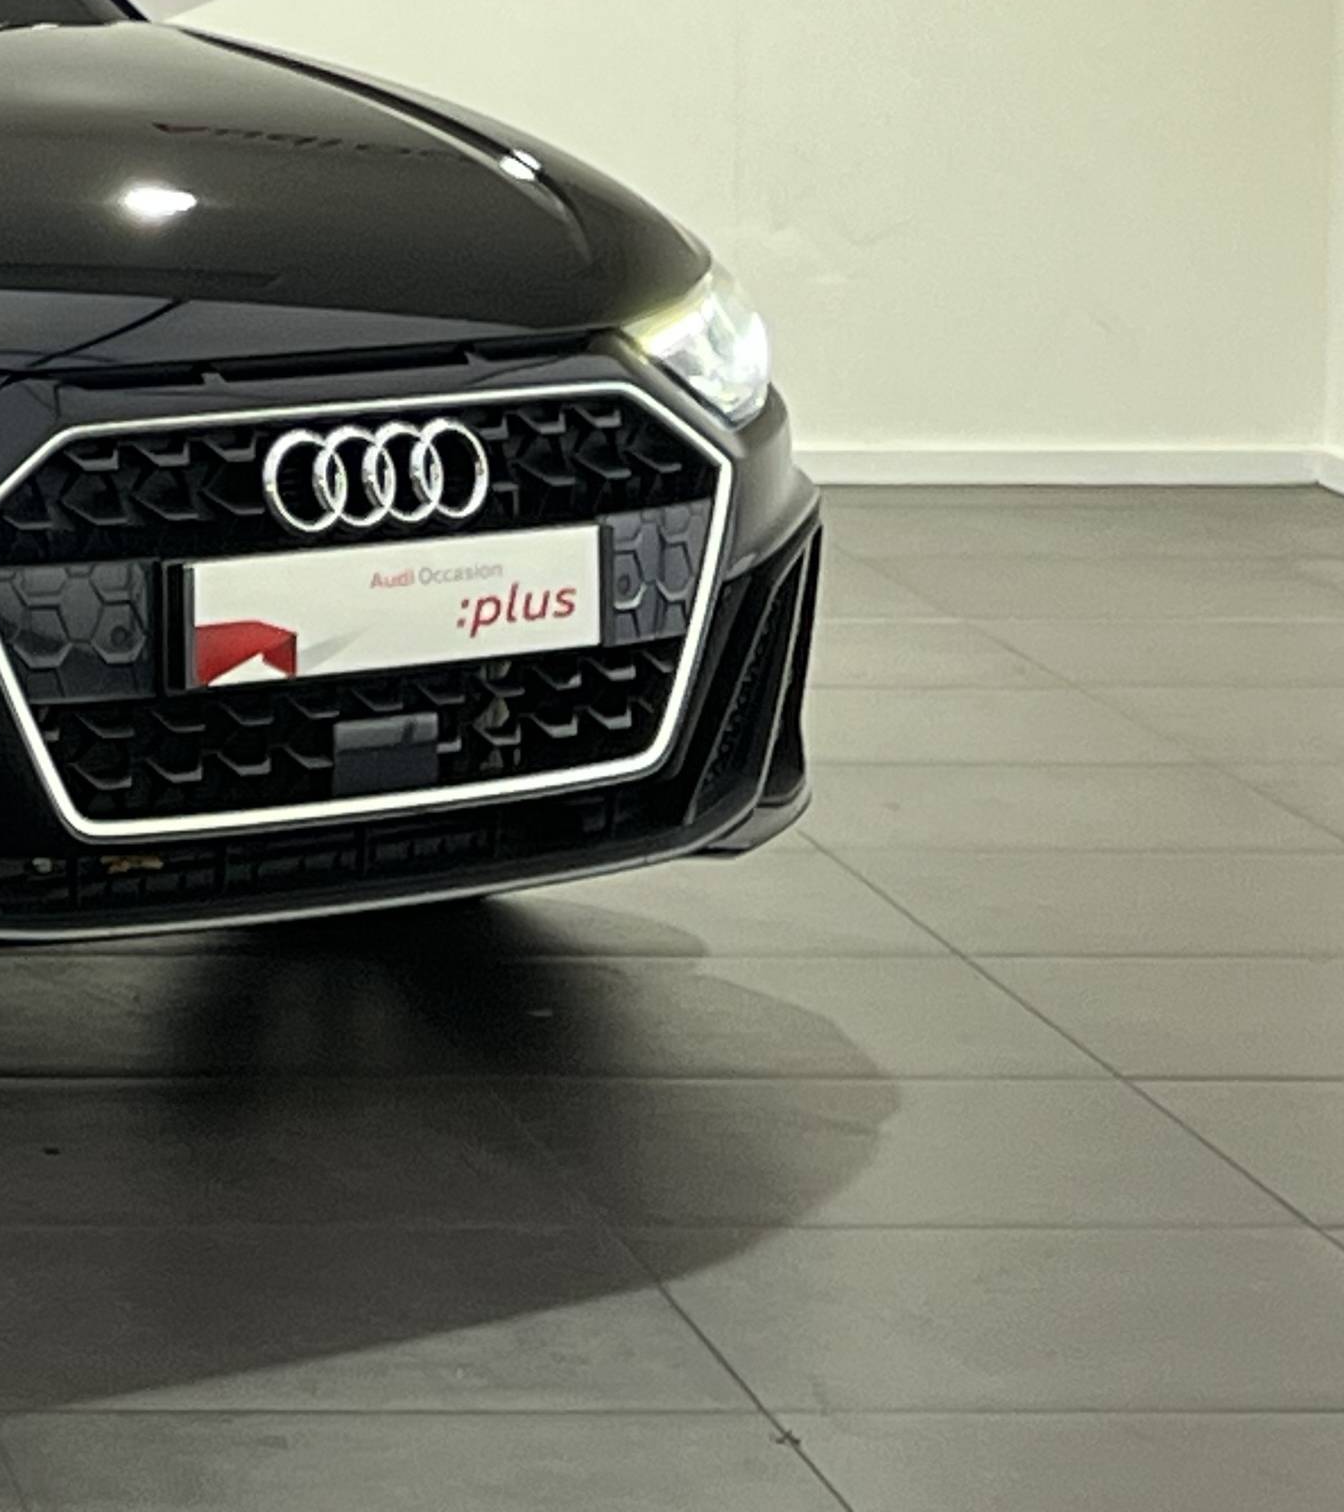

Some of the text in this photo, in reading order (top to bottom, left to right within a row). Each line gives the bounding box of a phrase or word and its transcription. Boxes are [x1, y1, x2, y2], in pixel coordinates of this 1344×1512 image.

[369, 563, 504, 589] Audi Occasion
[456, 580, 577, 639] :plus
